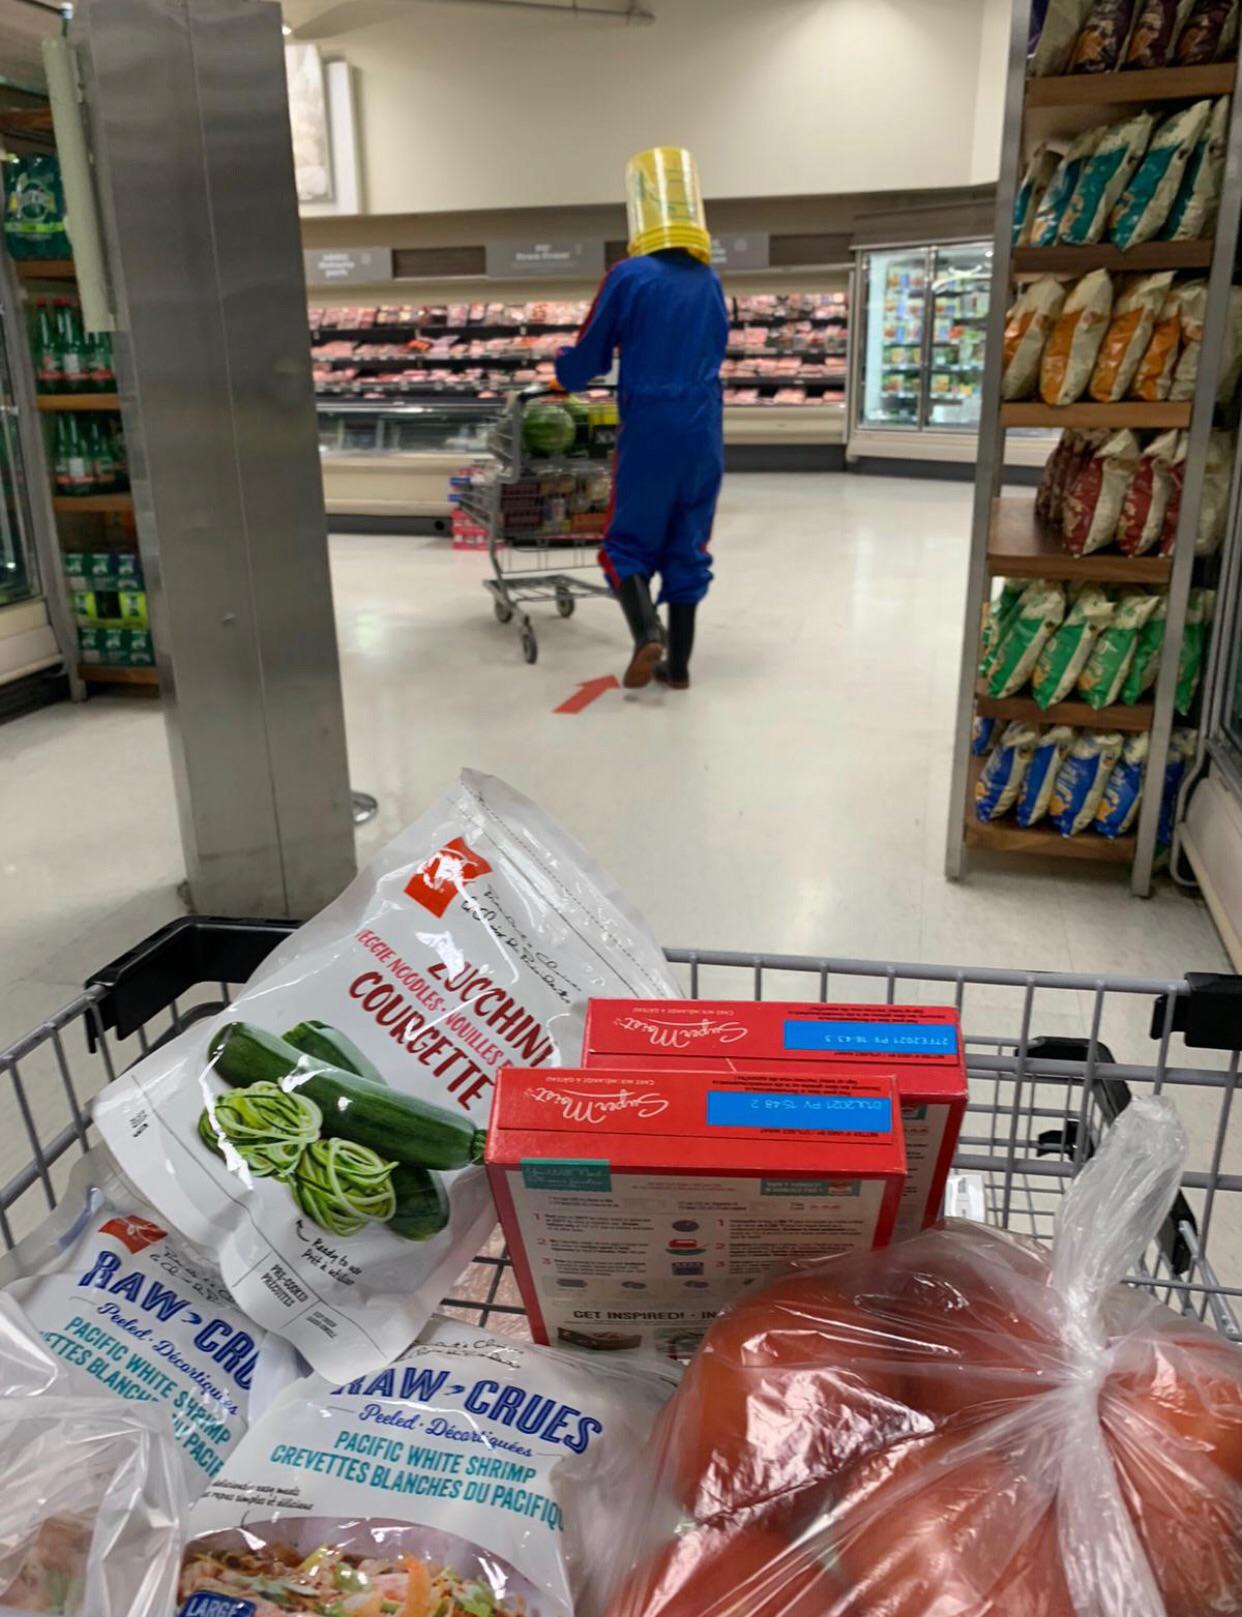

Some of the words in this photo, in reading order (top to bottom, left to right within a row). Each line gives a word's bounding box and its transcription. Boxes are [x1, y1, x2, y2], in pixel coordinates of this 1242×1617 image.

[349, 971, 495, 1111] COURGETTE
[386, 957, 445, 1012] NOODLES
[446, 1009, 504, 1066] NOUILLES
[78, 1250, 191, 1322] RAW
[573, 1310, 601, 1320] GET
[607, 1311, 685, 1321] INSPIRED!
[97, 1302, 150, 1341] Peeled
[41, 1331, 93, 1367] ETTES
[86, 1357, 159, 1403] BLANCH
[64, 1316, 129, 1362] PACIFIC
[125, 1353, 178, 1399] WHITE
[358, 1403, 418, 1431] Peeled
[423, 1418, 534, 1458] Décortiquées
[463, 1379, 603, 1455] CRUES
[270, 1444, 371, 1485] CREVETTES
[370, 1465, 460, 1501] BLANCHES
[463, 1480, 491, 1504] DU
[334, 1430, 401, 1463] PACIFIC
[406, 1444, 465, 1475] WHITE
[465, 1455, 537, 1484] SHRIMP
[185, 1597, 239, 1617] LARGE
